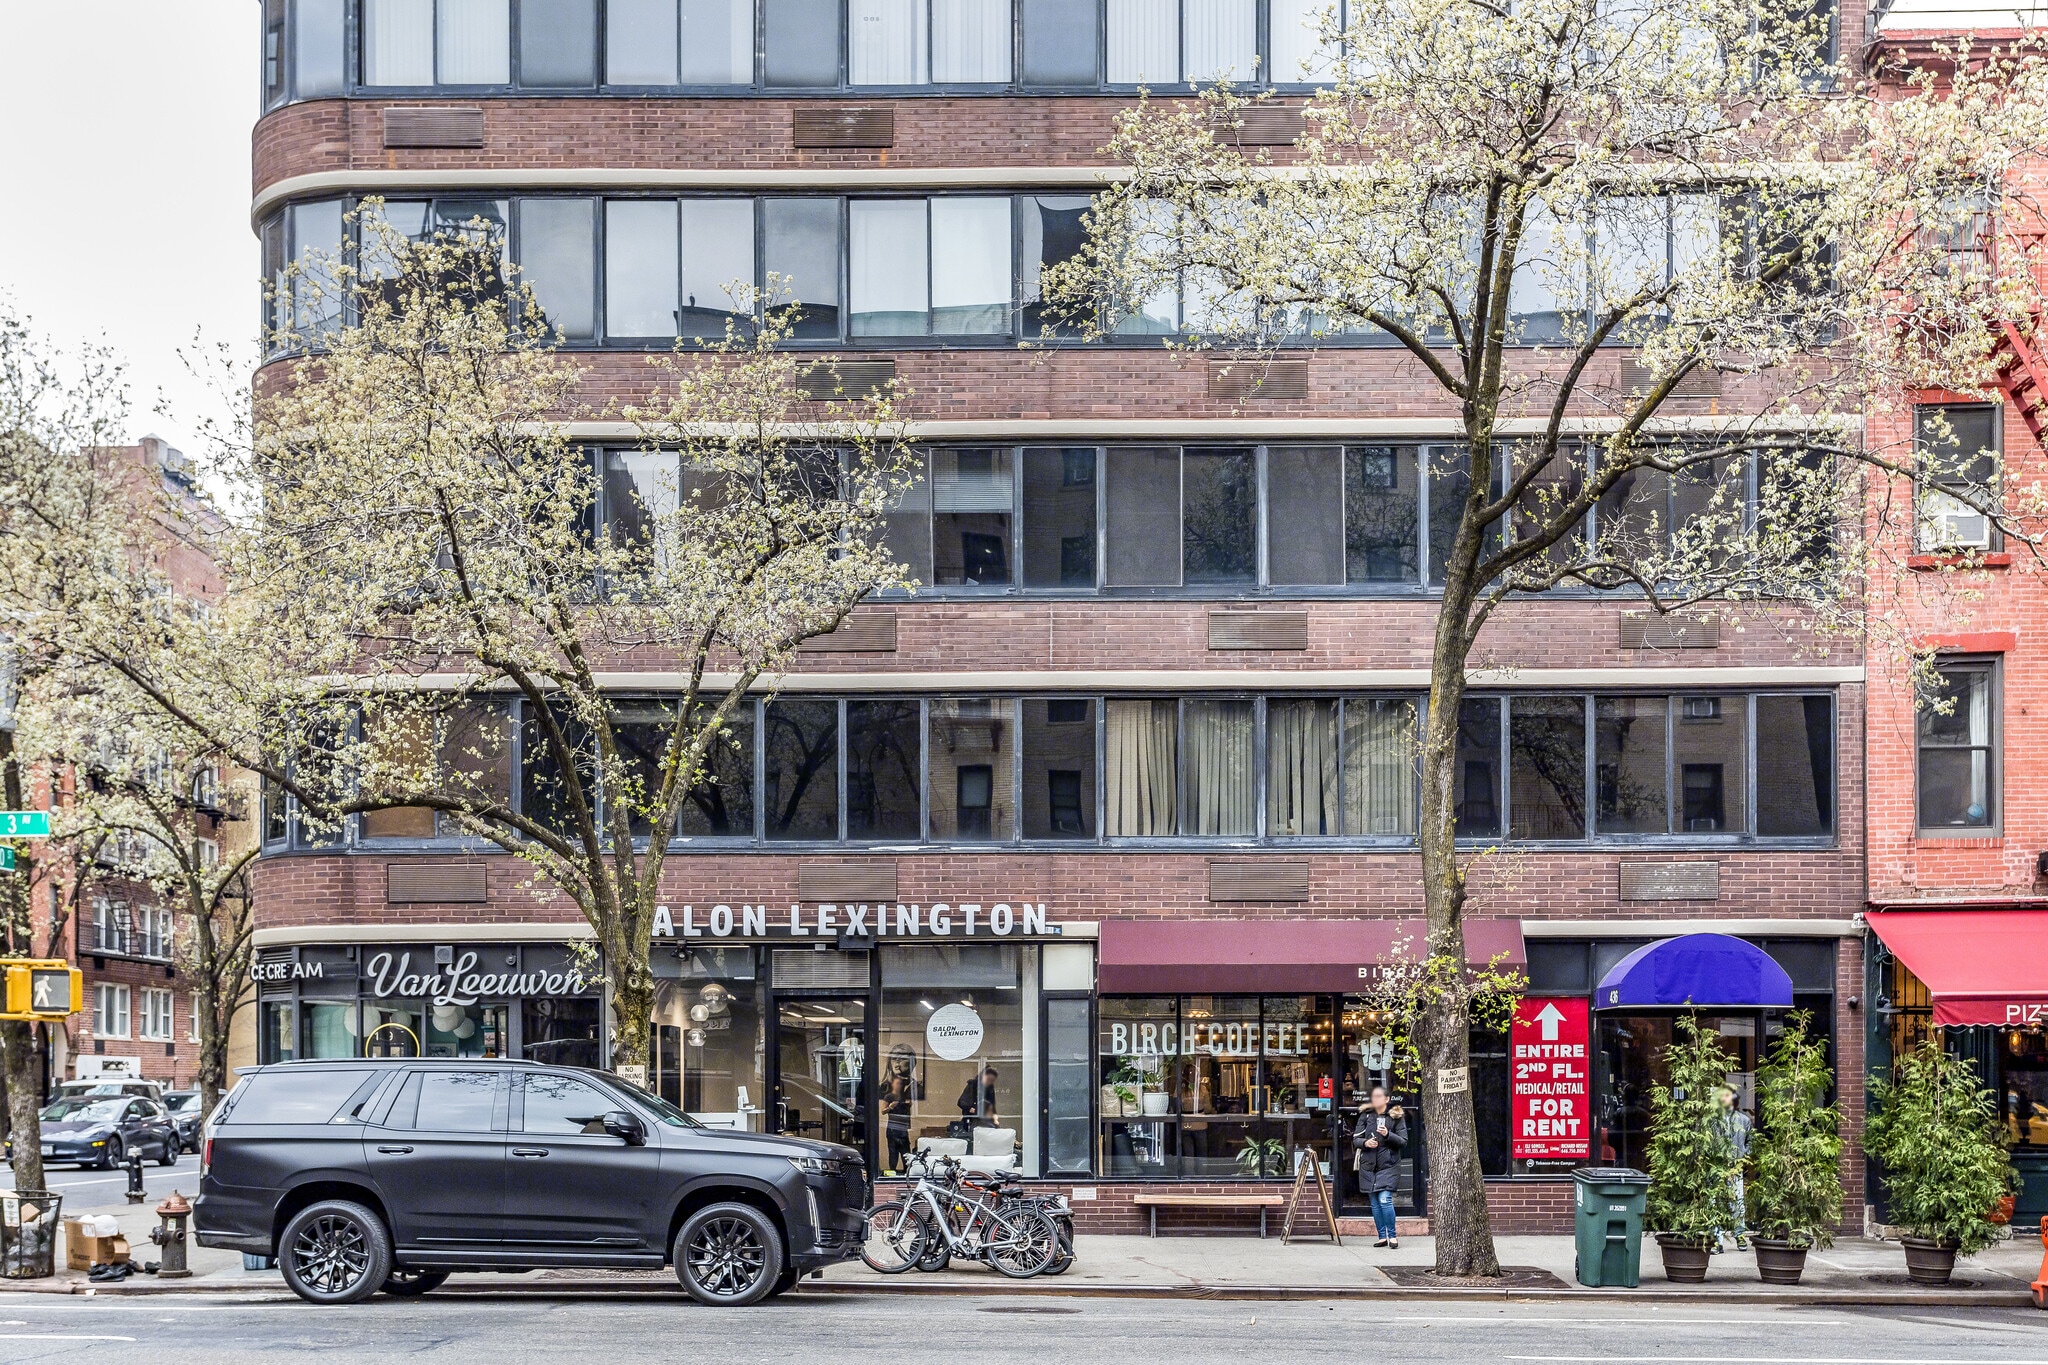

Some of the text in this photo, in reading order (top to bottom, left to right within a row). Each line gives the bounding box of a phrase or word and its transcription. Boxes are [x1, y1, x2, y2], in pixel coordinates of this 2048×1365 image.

[7, 814, 17, 834] 3
[651, 903, 1046, 937] ALON LEXINGTON
[266, 962, 323, 979] CREAM
[367, 951, 588, 1006] Van Leeuwen
[1609, 989, 1618, 1004] 436
[939, 1029, 980, 1037] LEXINGTON
[1112, 1022, 1310, 1056] BIRCH COFFEE
[1515, 1044, 1585, 1058] ENTIRE
[1440, 1074, 1466, 1083] PARKING
[1515, 1062, 1584, 1079] 2ND FL.
[1443, 1082, 1464, 1090] FRIDAY
[1515, 1082, 1585, 1096] MEDICAL/RETAIL
[1529, 1098, 1574, 1117] FOR
[1522, 1118, 1581, 1137] RENT
